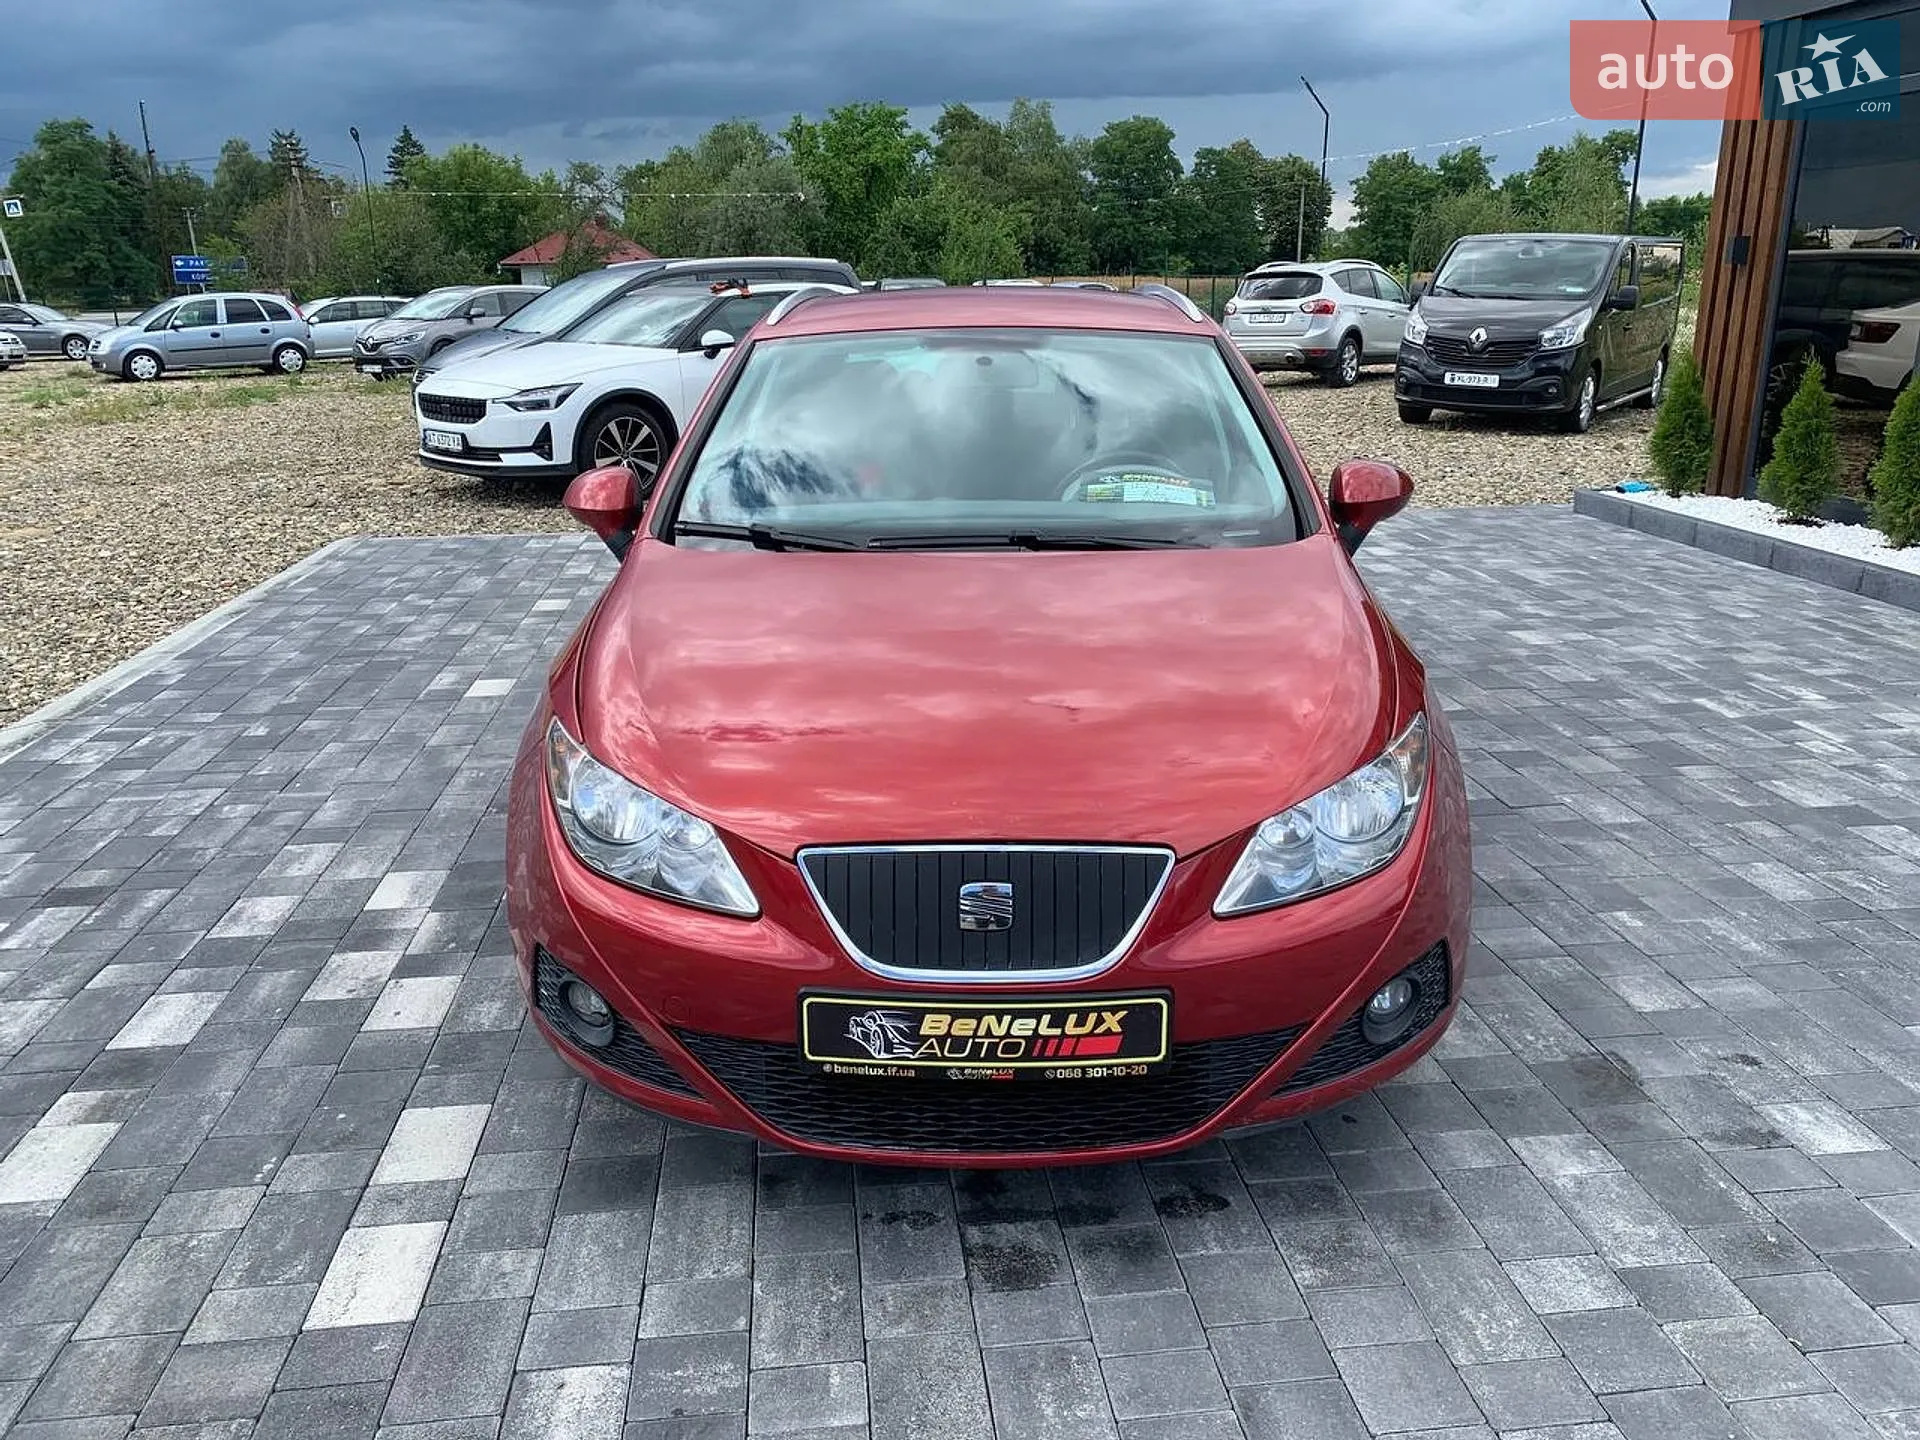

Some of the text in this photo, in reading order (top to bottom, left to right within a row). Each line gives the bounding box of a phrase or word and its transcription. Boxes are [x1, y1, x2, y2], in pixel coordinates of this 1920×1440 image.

[919, 1010, 1128, 1036] BeNeLUX
[914, 1038, 1026, 1058] AUTO
[833, 1063, 916, 1078] benelux.if.ua
[1086, 1065, 1148, 1078] 301-10-20
